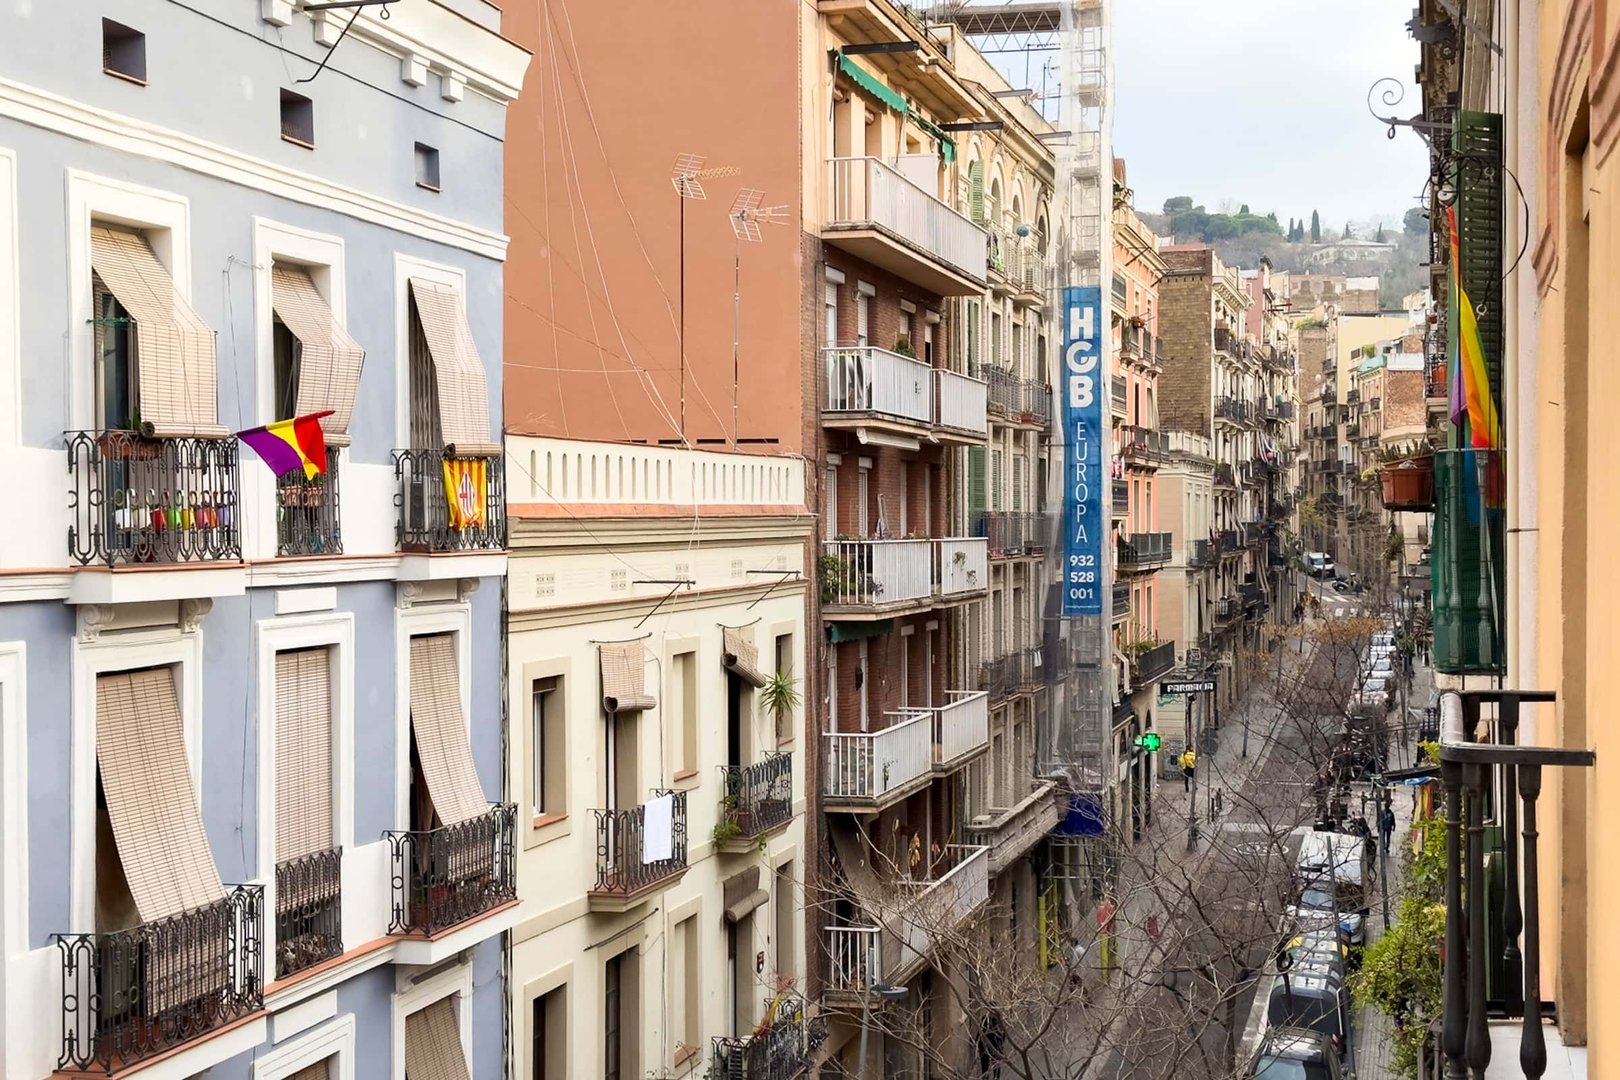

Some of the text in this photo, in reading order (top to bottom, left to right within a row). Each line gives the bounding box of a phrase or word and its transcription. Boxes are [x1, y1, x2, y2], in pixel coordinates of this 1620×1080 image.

[1066, 307, 1098, 543] HGB EUROPA
[1070, 554, 1095, 567] 932
[1070, 571, 1095, 583] 528
[1070, 587, 1094, 600] 001
